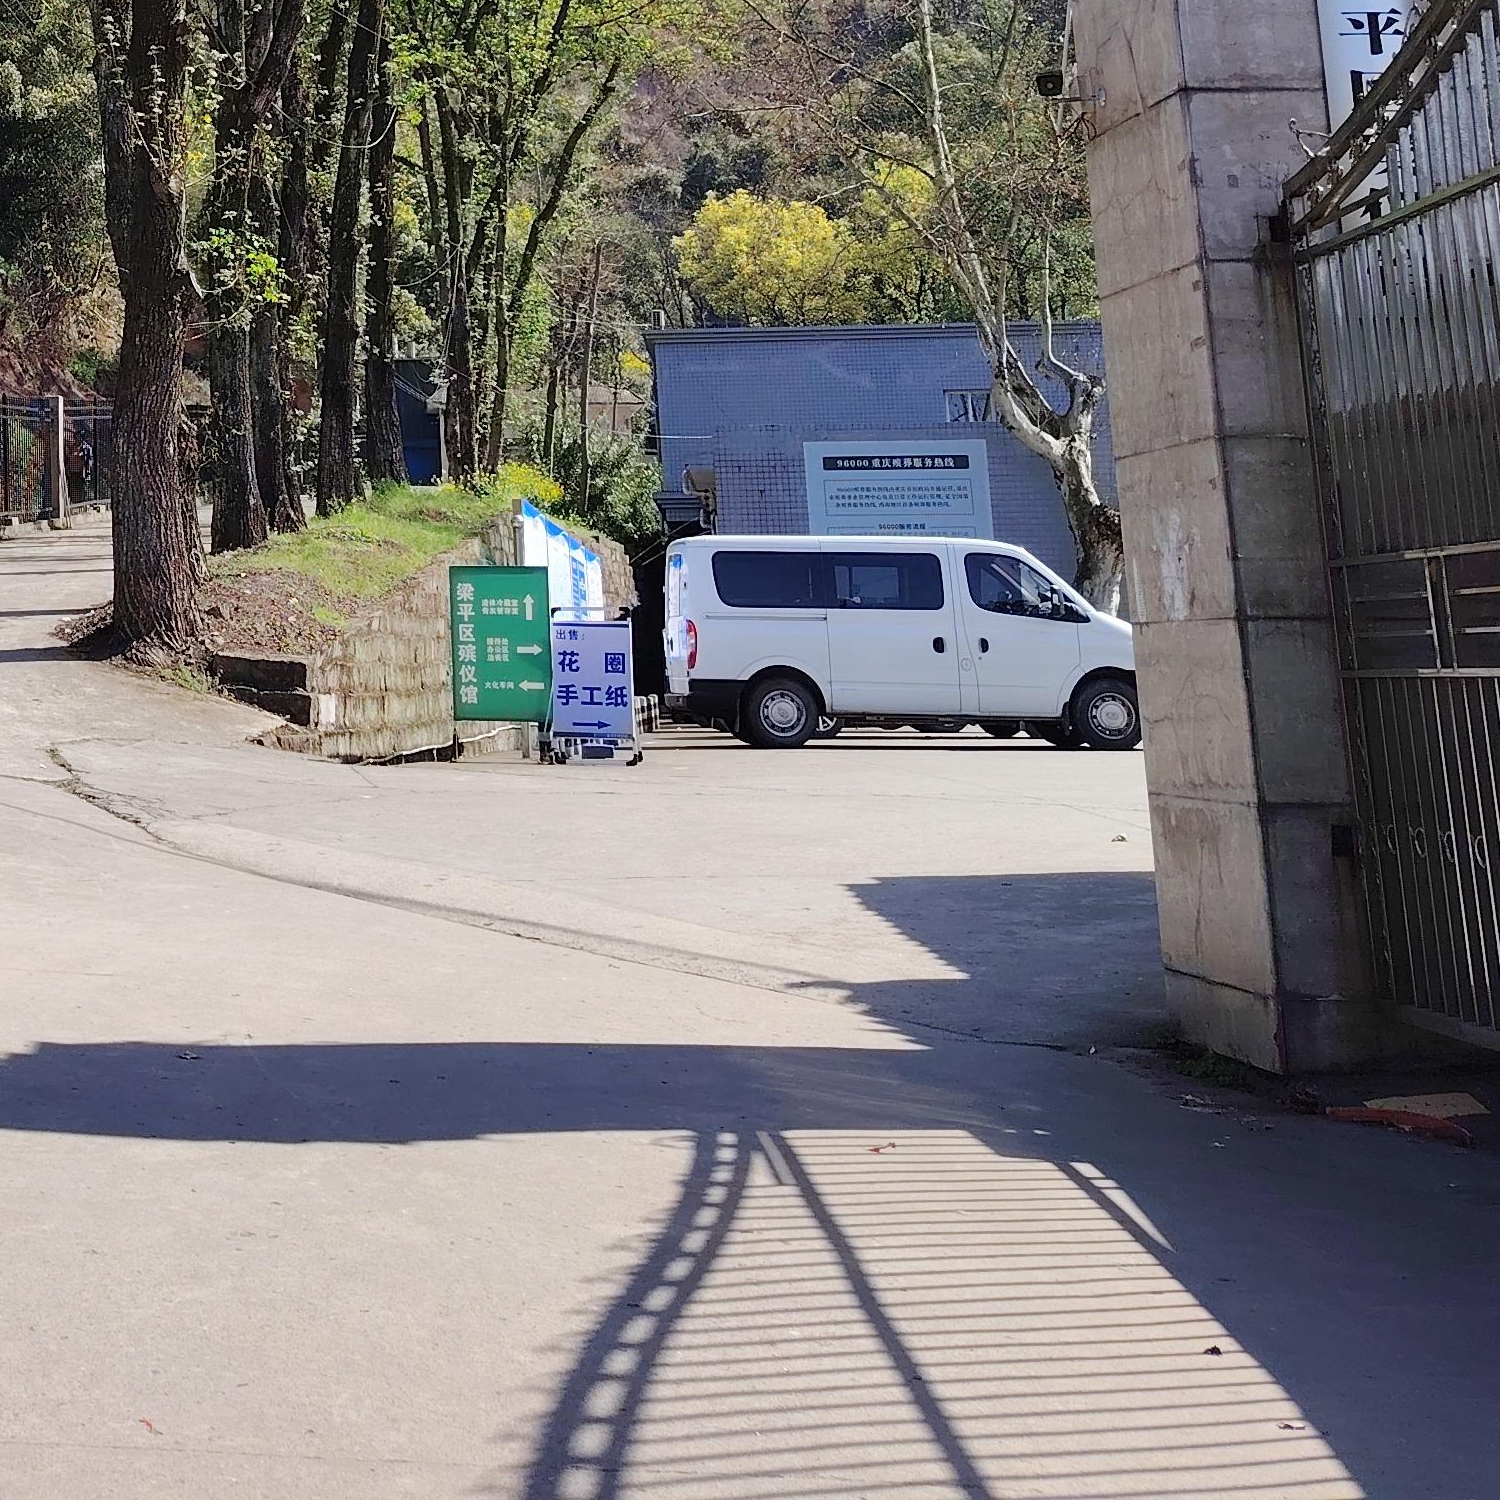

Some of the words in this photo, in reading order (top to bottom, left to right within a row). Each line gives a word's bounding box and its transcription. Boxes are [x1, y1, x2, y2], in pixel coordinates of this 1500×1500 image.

[456, 583, 478, 704] 梁平区殡仪馆
[556, 683, 629, 708] 手工纸
